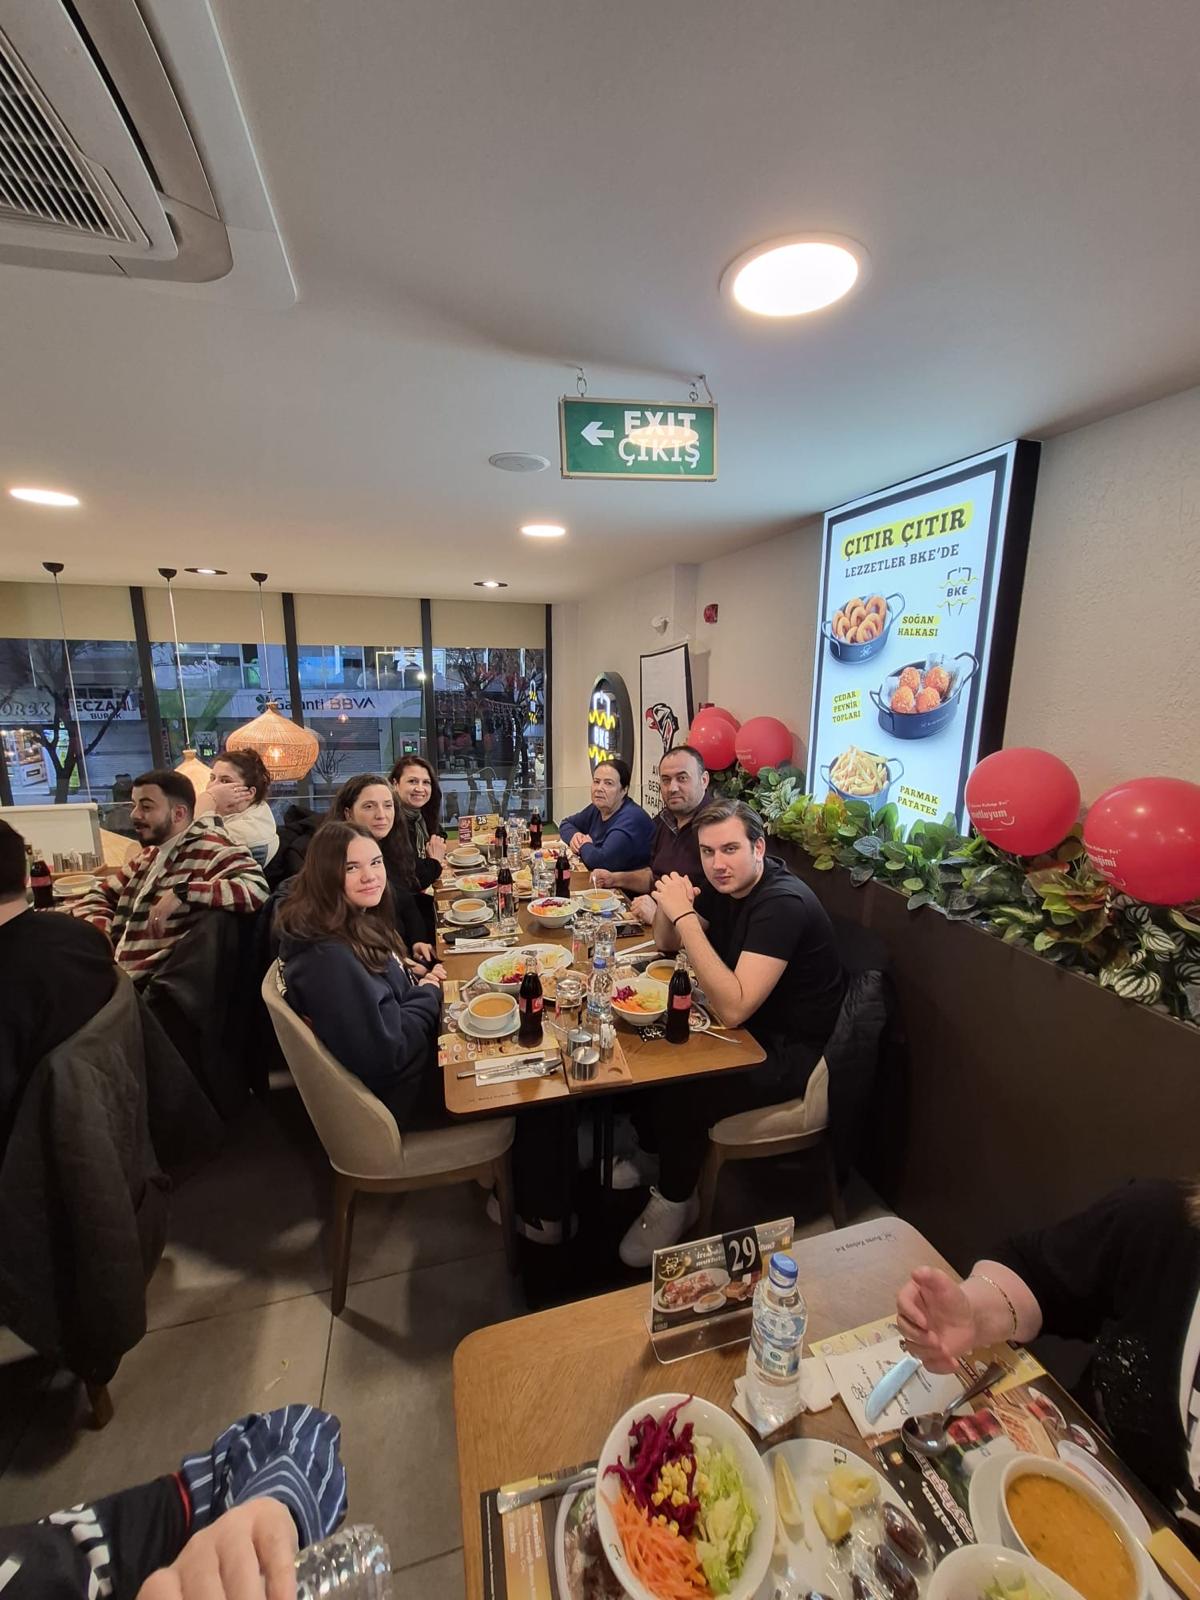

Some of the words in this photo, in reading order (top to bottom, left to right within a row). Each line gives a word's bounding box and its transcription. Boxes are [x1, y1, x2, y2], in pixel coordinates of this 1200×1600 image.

[624, 411, 696, 435] EXIT
[618, 438, 700, 468] ÇIKIŞ
[844, 528, 895, 561] ÇITIR
[901, 508, 967, 548] ÇITIR
[845, 555, 906, 578] LEZZETLER
[910, 543, 960, 565] BKE'DE
[946, 585, 968, 597] BKE
[902, 613, 934, 625] SOĞAN
[897, 627, 938, 637] HALKASI
[329, 695, 376, 710] BBVA
[832, 710, 861, 723] TOPLARI
[900, 785, 938, 804] PARMAK
[897, 796, 937, 816] PATATES
[478, 815, 487, 825] 28
[728, 1236, 756, 1272] 29
